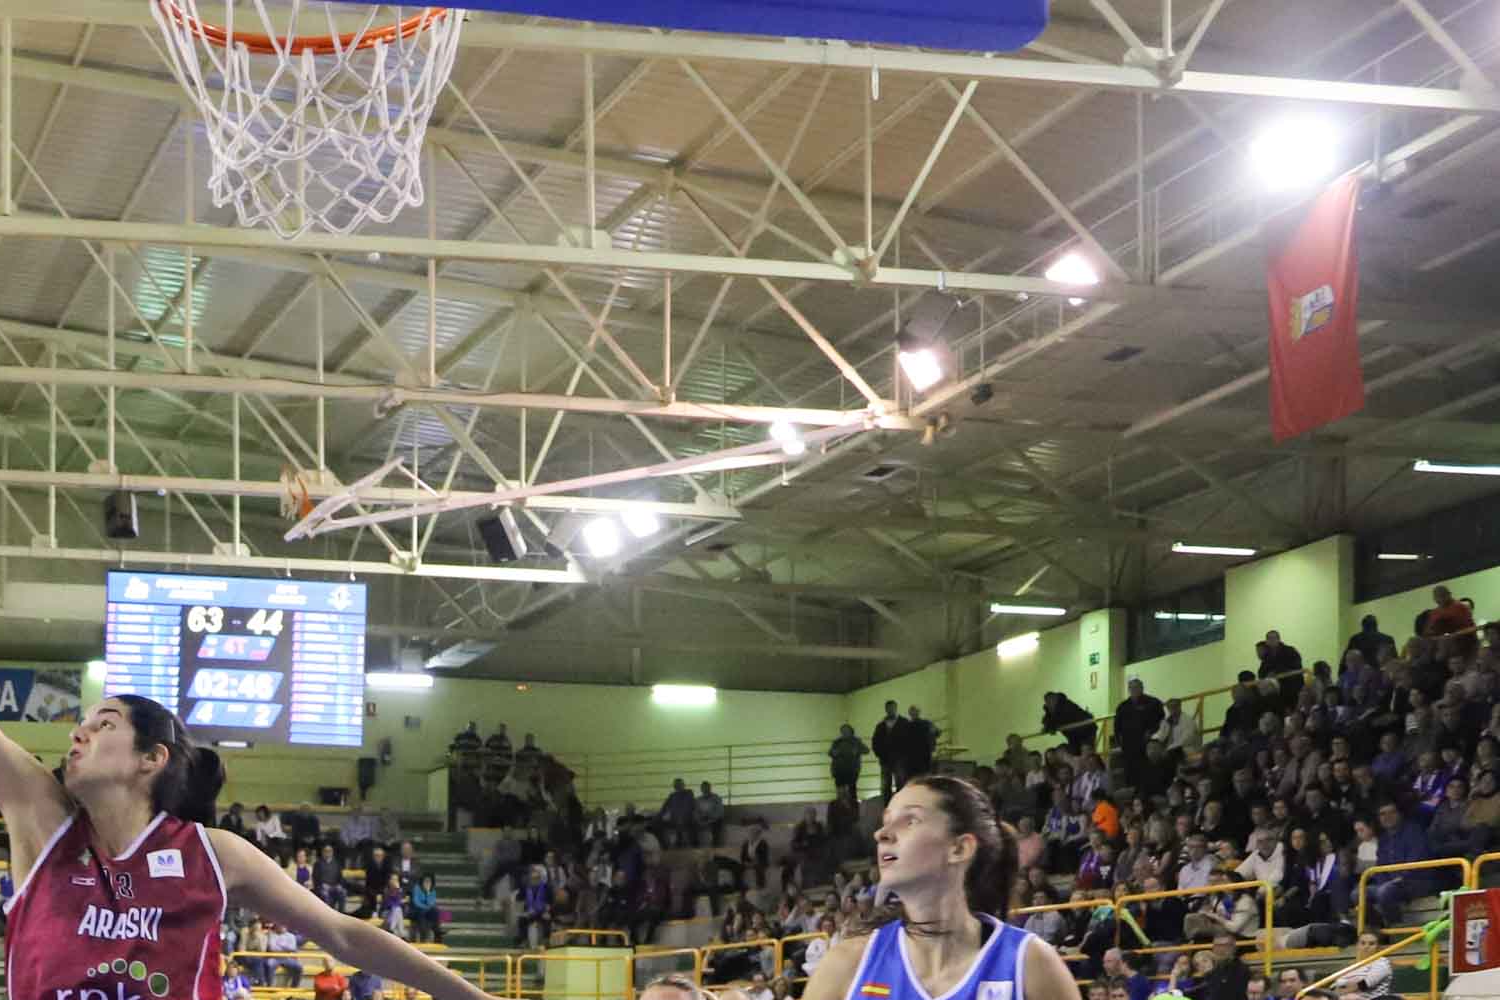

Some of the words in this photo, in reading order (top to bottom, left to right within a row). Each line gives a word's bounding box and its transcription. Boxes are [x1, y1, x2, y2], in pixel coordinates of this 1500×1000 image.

[187, 606, 224, 632] 63
[246, 609, 284, 635] 44
[78, 904, 163, 942] ARASKI
